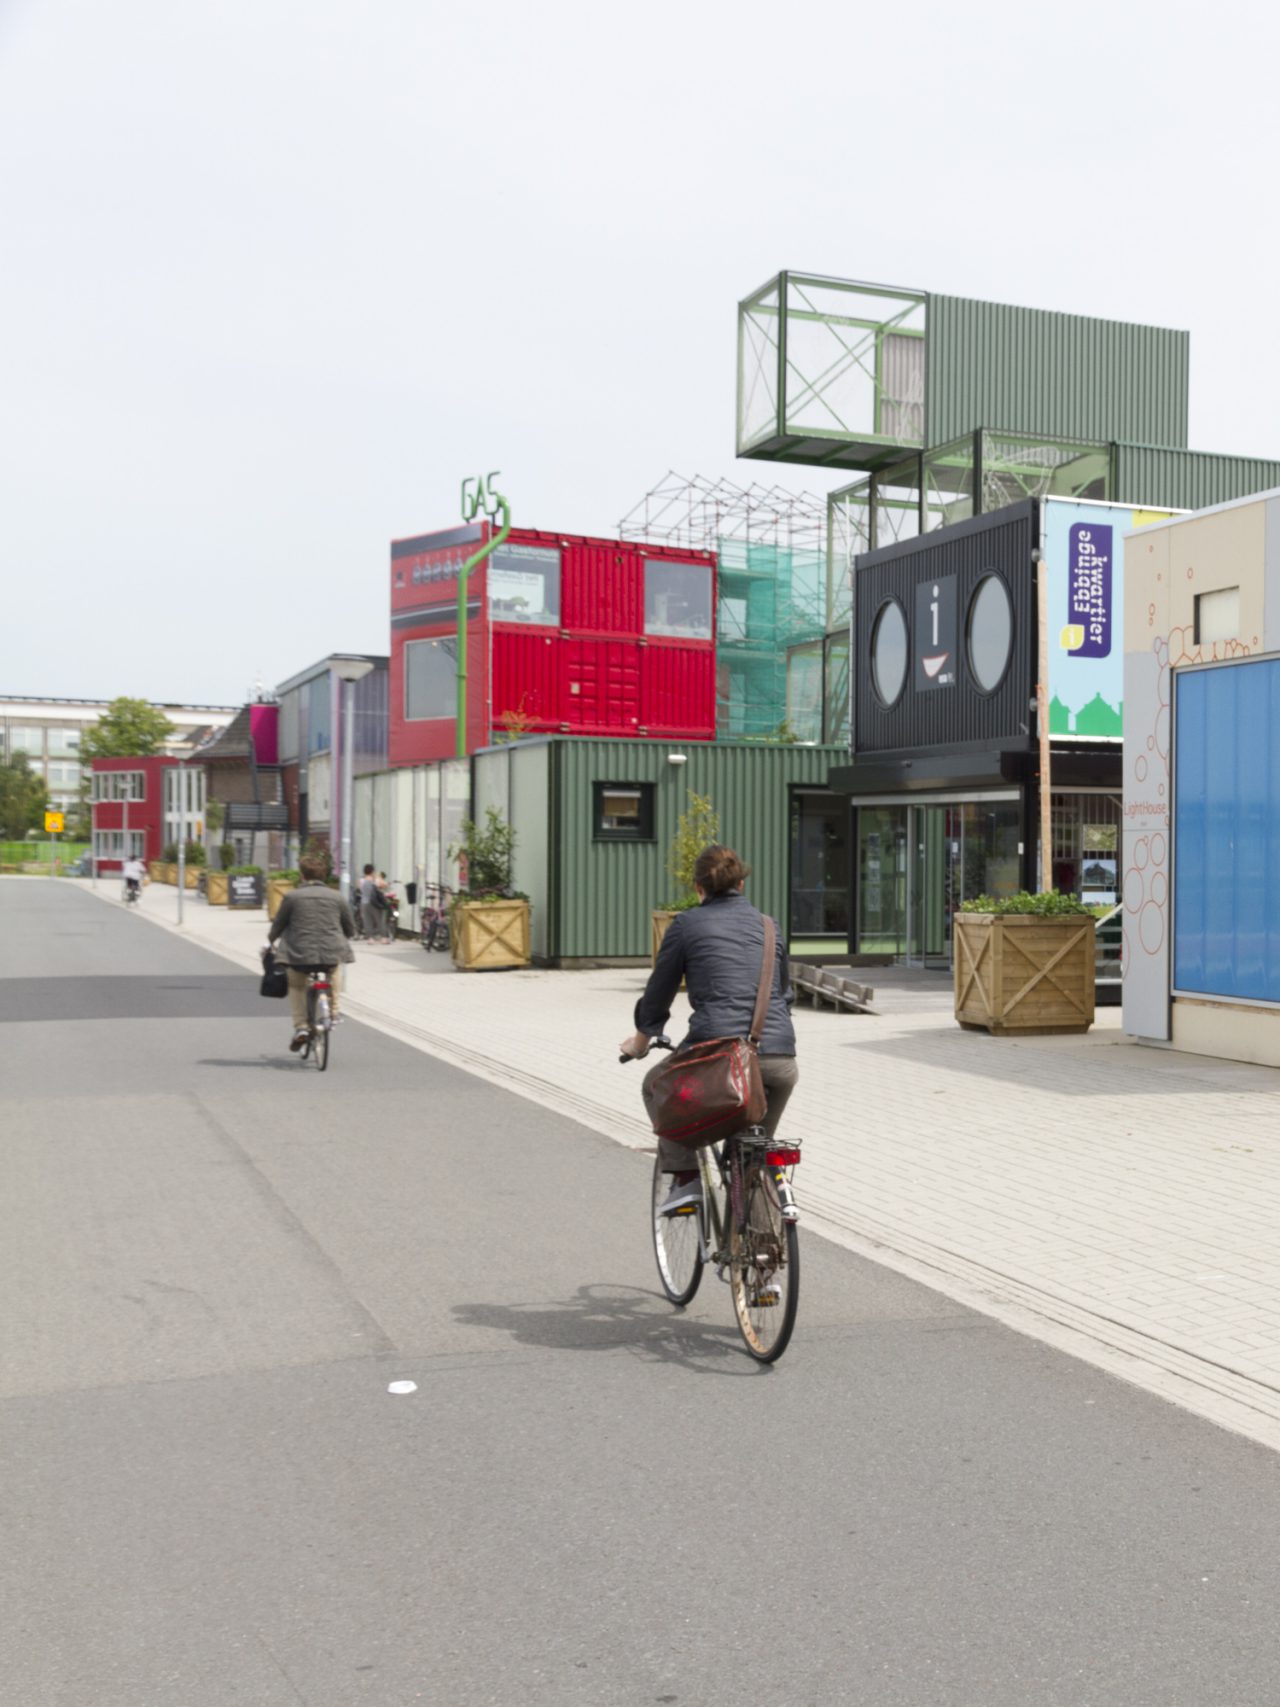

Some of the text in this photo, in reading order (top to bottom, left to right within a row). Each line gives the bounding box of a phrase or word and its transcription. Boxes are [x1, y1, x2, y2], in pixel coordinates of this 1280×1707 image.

[461, 470, 502, 519] GAS
[1073, 530, 1096, 612] Ebbinge
[1090, 556, 1107, 645] kwartier
